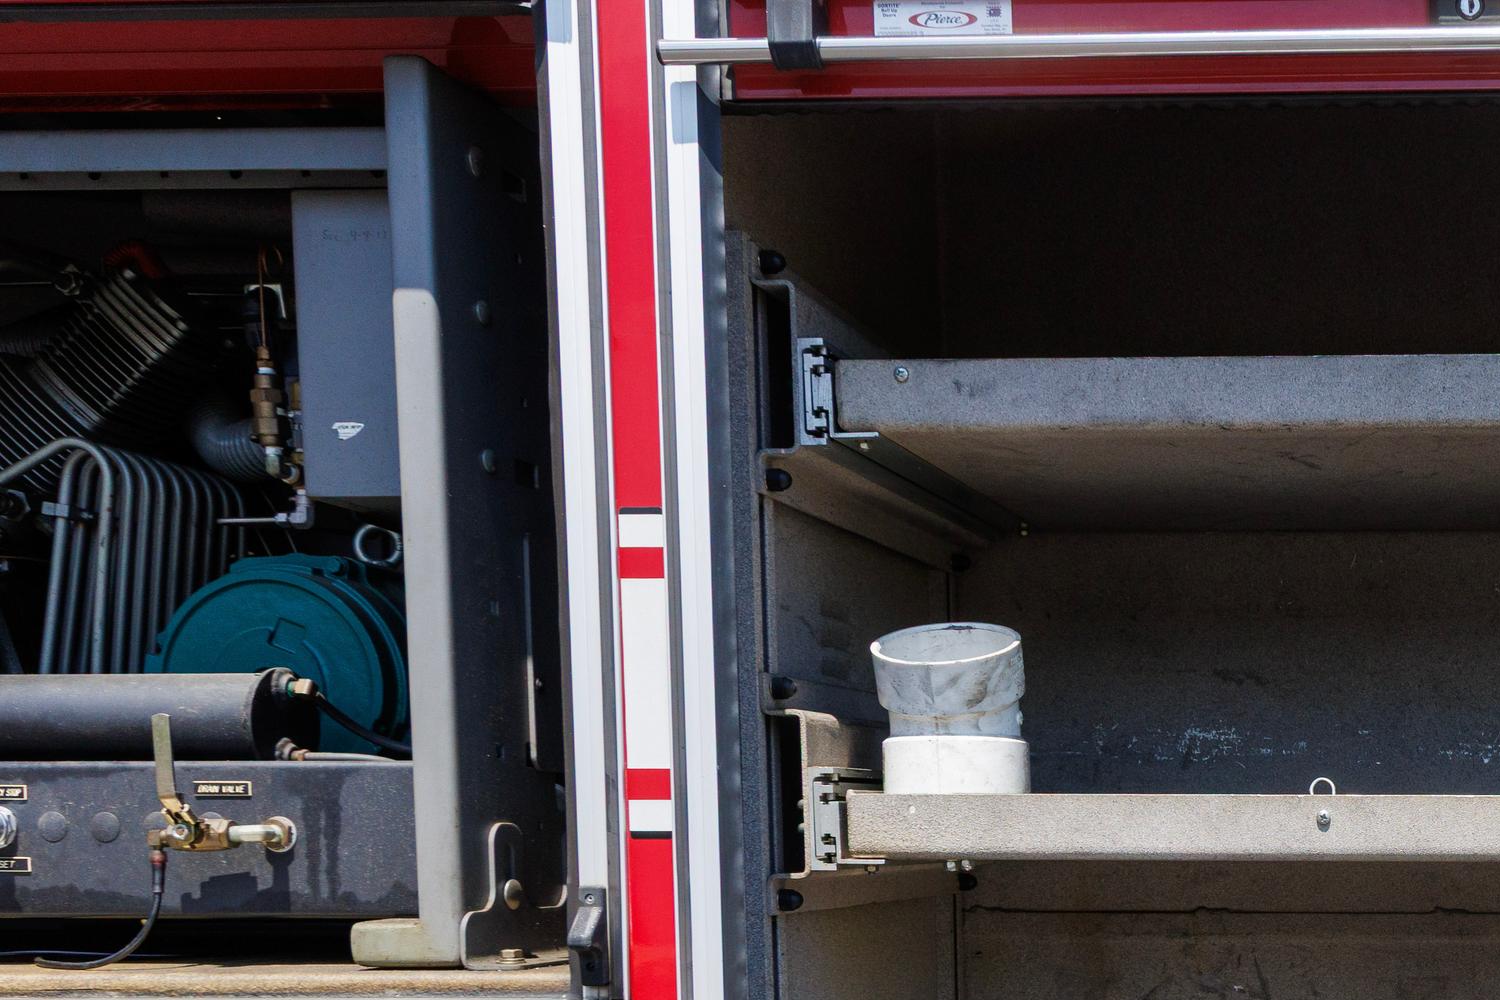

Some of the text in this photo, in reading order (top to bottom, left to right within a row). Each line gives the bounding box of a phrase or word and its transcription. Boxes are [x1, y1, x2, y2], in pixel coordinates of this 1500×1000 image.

[924, 12, 962, 25] Pierce
[197, 784, 247, 793] DRAIN VALVE
